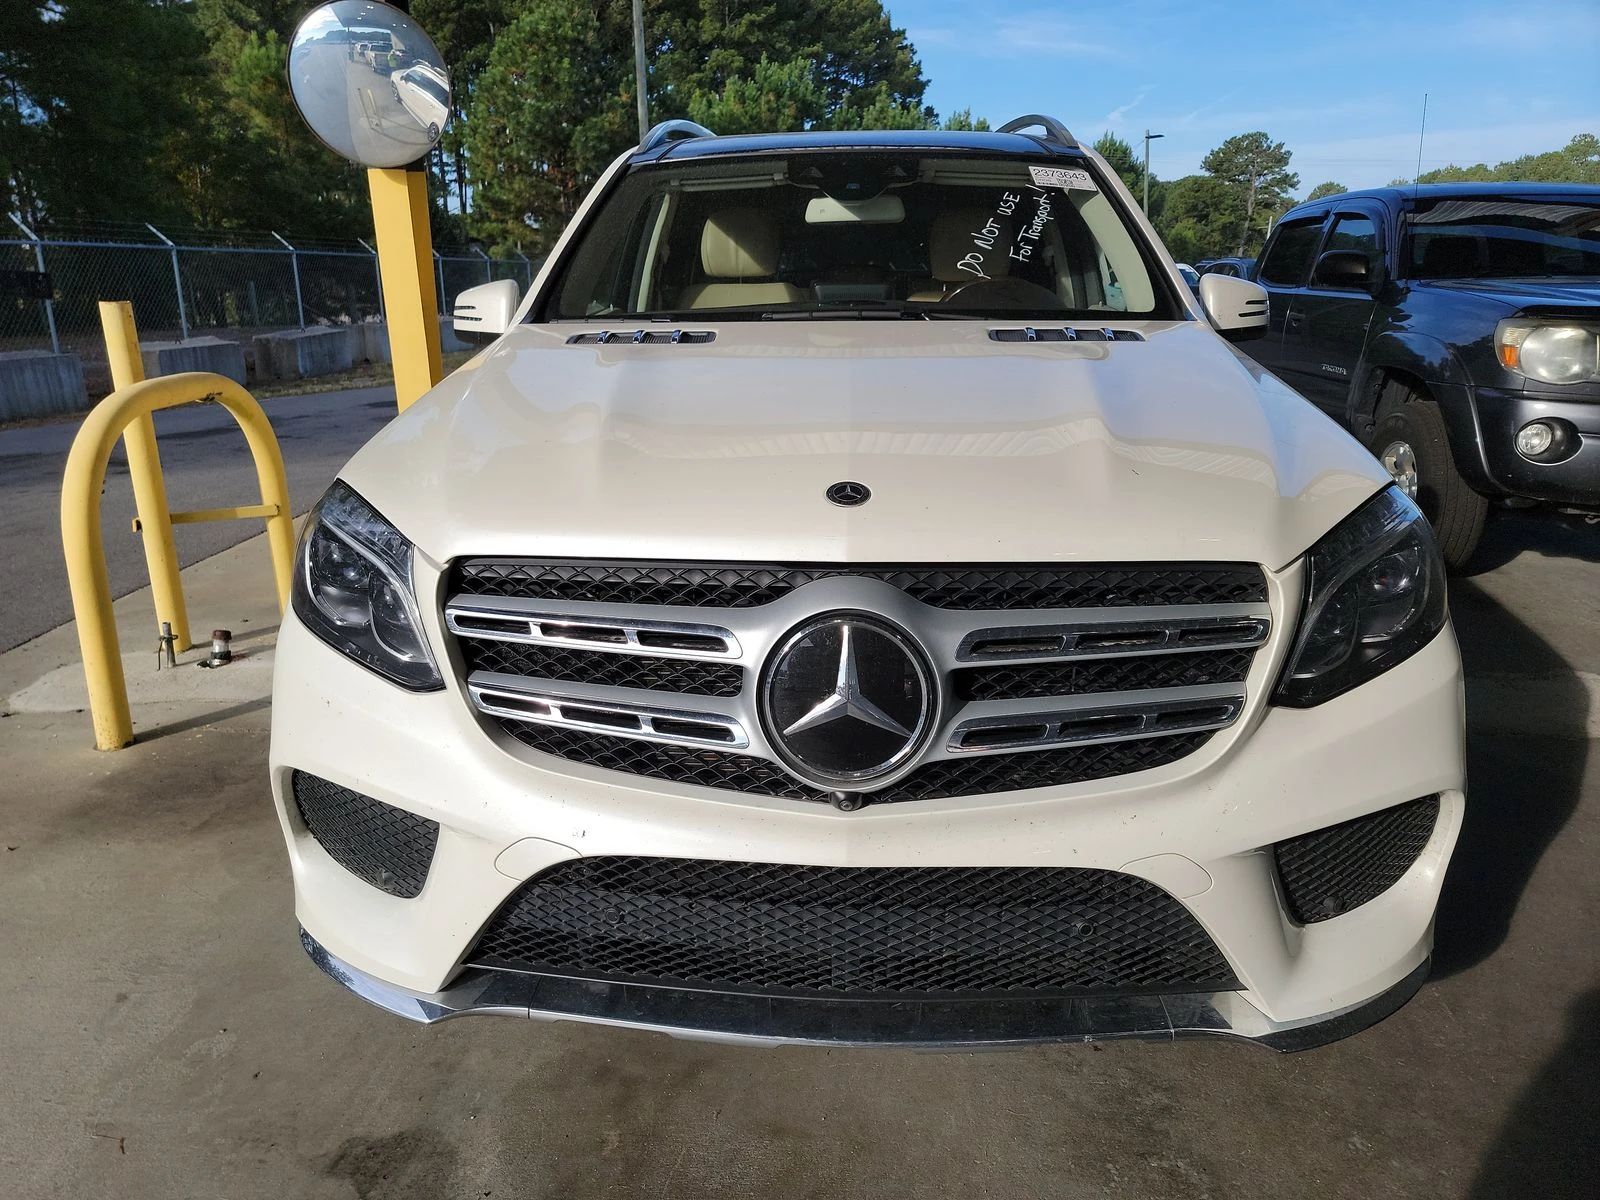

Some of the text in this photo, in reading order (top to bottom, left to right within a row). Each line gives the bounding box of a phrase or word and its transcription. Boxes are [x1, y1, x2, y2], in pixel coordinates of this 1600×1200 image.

[1033, 169, 1087, 181] 2373643
[971, 217, 1001, 250] NOT
[1009, 241, 1034, 263] For
